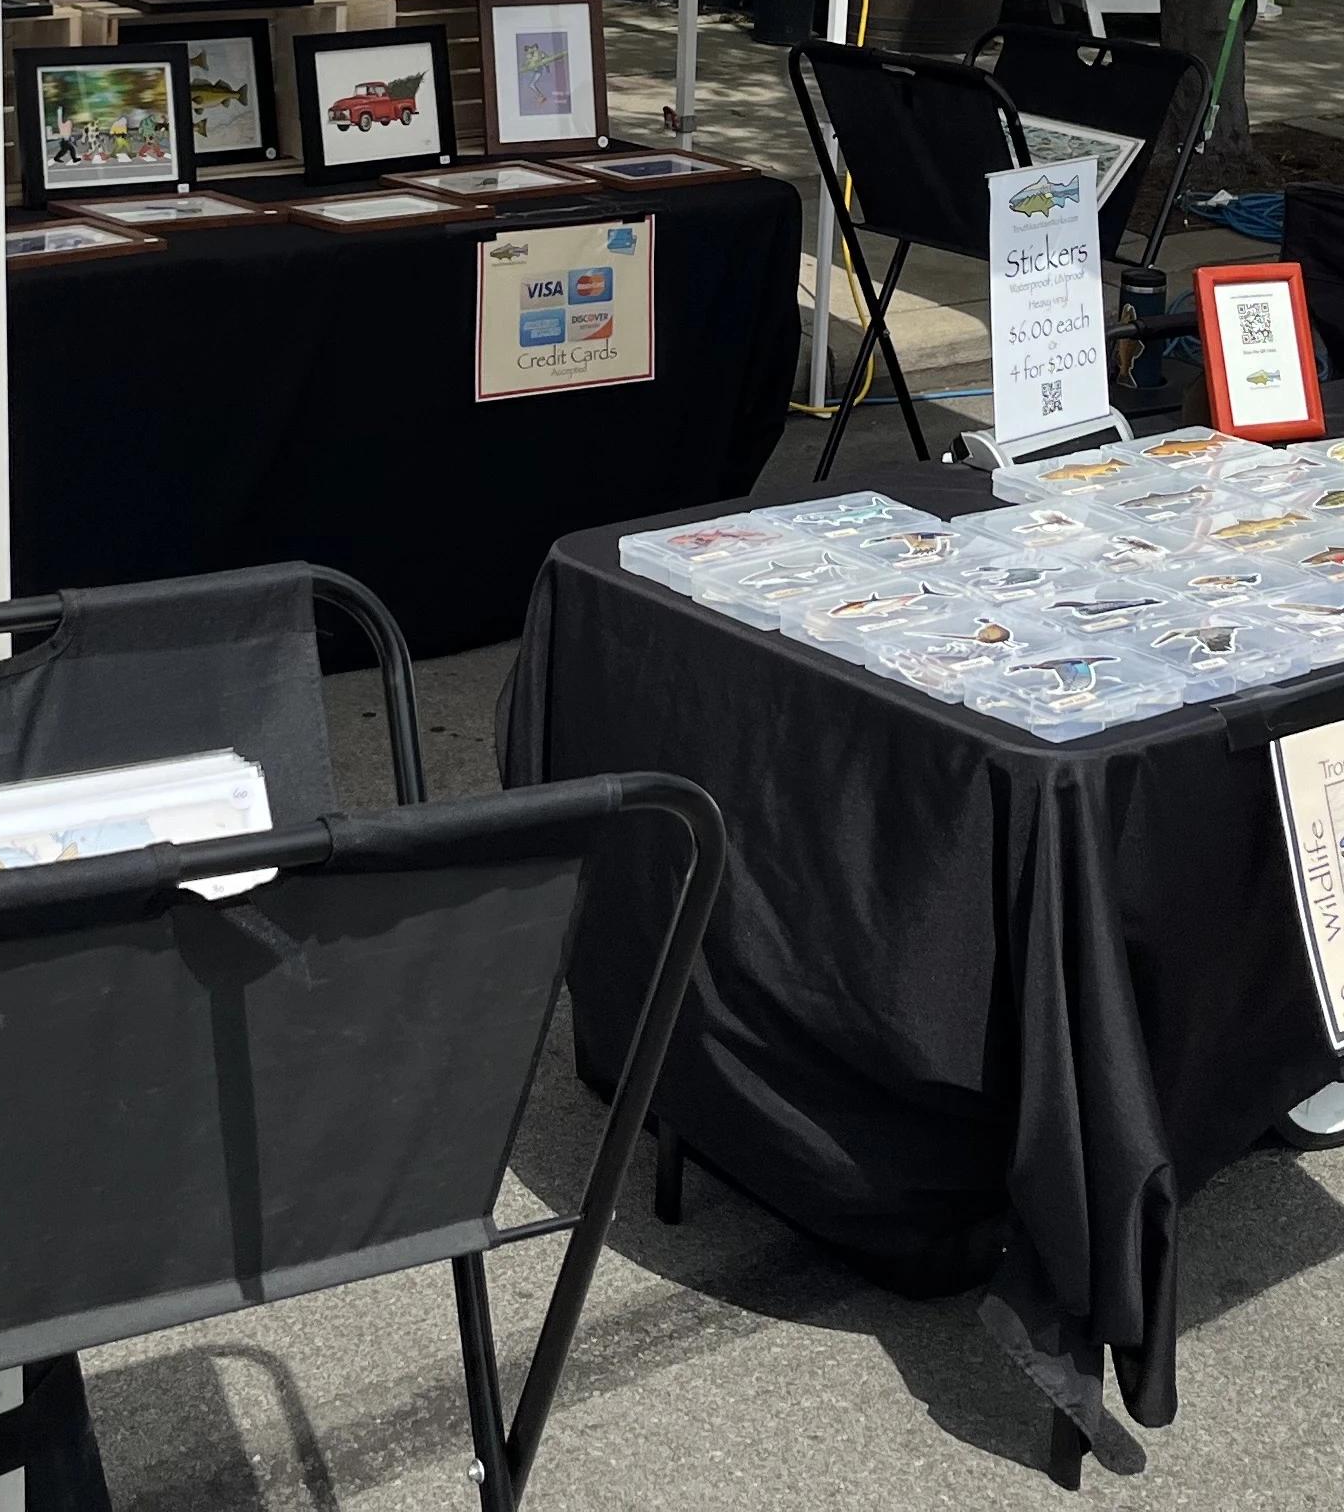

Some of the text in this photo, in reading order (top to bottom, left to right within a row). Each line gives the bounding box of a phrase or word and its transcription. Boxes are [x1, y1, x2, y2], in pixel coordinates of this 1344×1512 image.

[1004, 233, 1088, 278] Stickers
[527, 281, 565, 299] VISA
[571, 313, 609, 324] DISCOVER
[1009, 303, 1090, 345] $6.00 each
[517, 338, 618, 369] Credit Cards
[1009, 347, 1097, 383] 4 for $20.00
[1303, 818, 1342, 942] Wildlife
